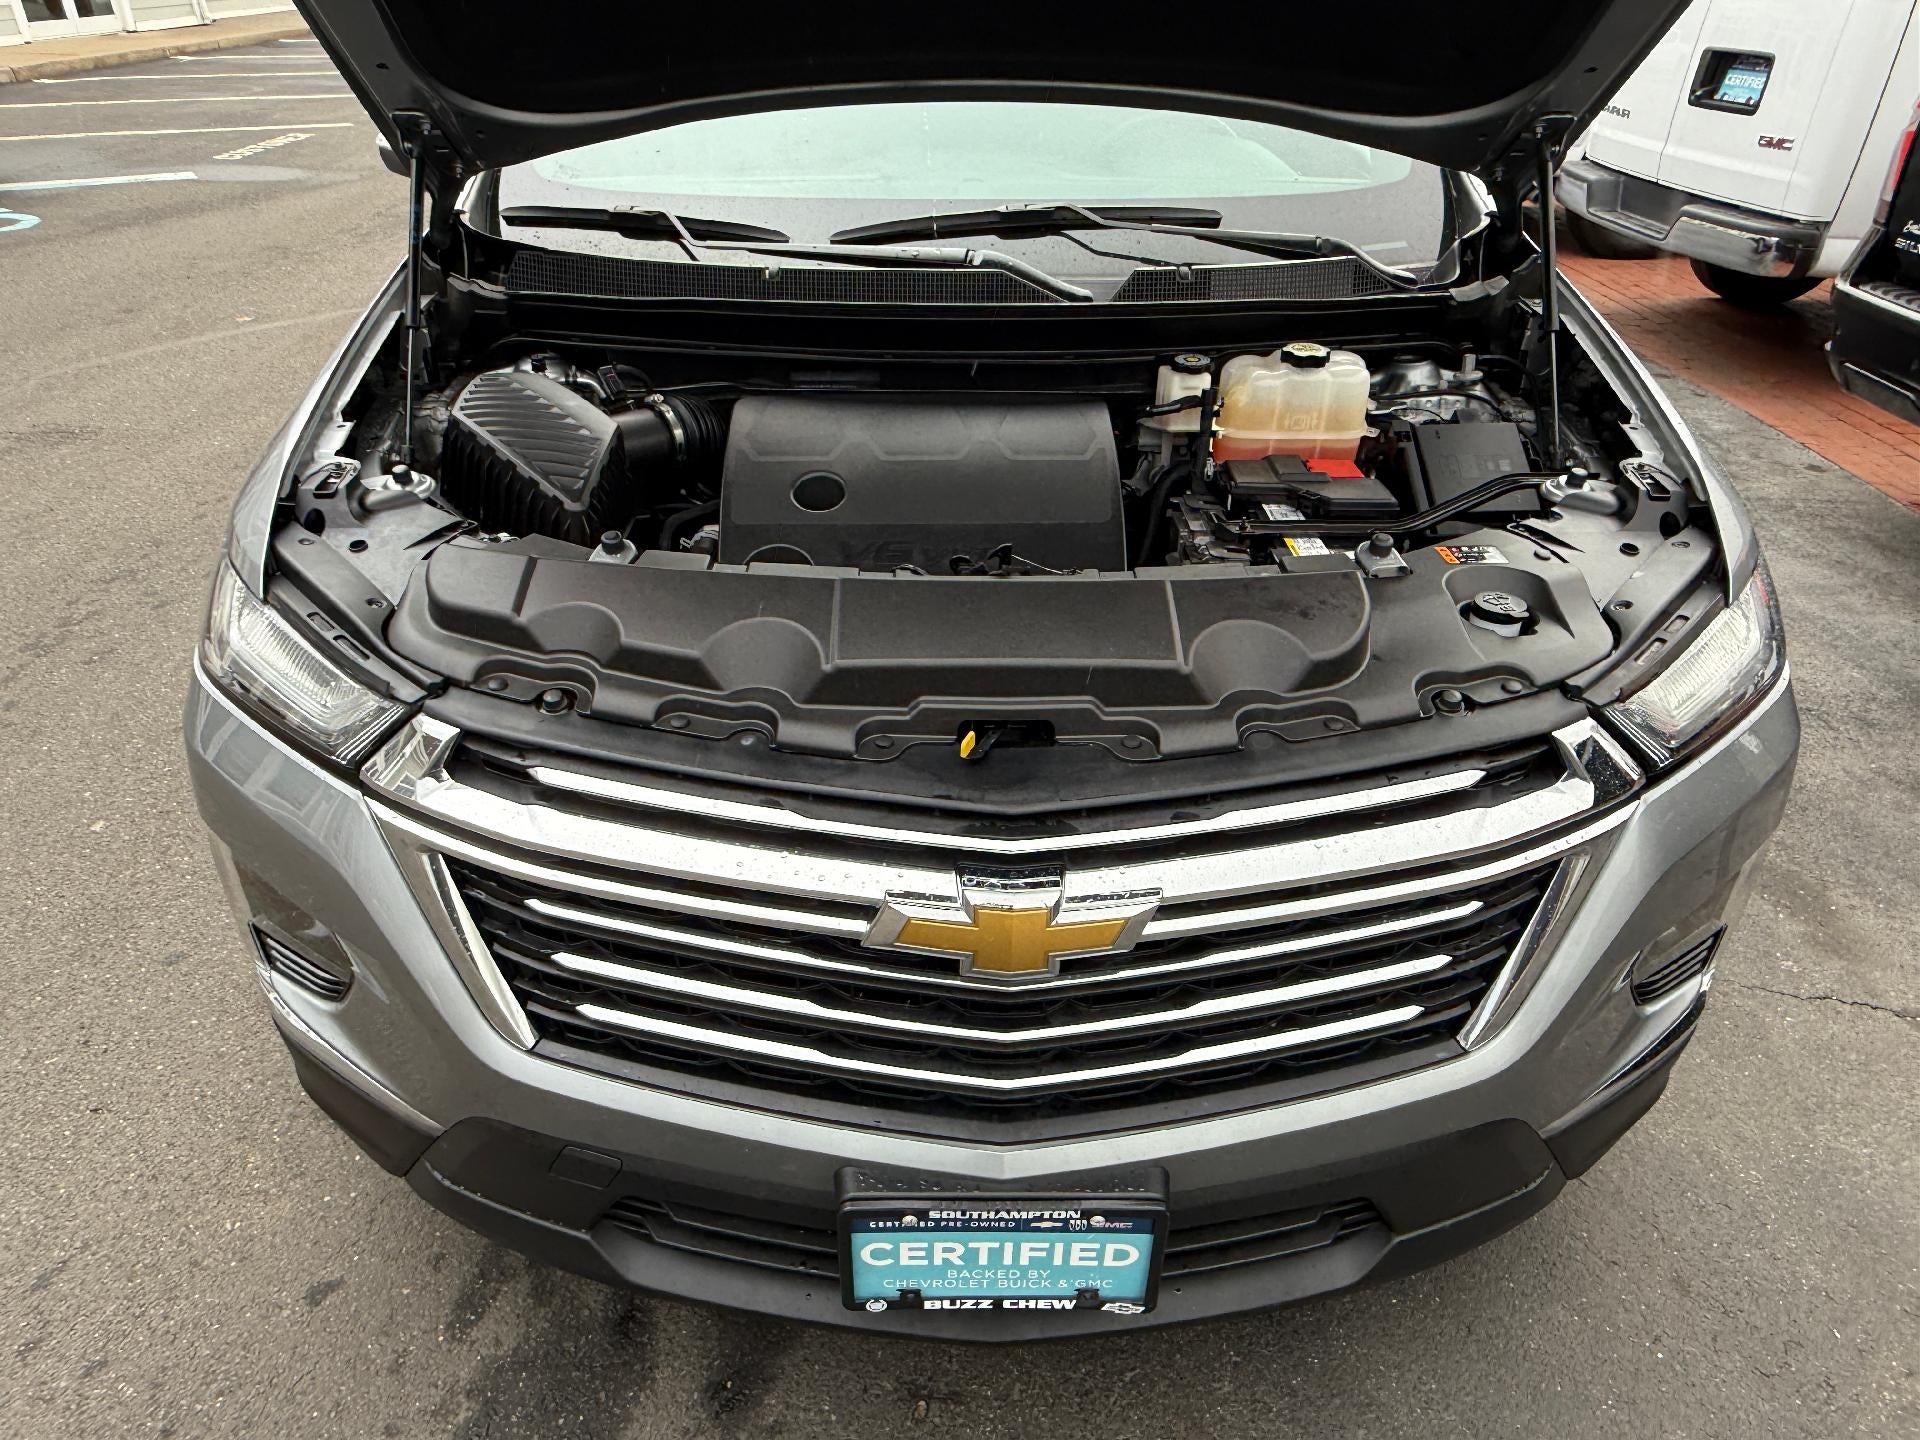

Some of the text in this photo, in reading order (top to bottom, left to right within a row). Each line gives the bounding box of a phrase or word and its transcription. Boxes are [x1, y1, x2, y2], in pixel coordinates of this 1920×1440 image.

[1758, 135, 1795, 151] GMC
[928, 1210, 1081, 1219] SOUTHAMPTON
[860, 1241, 1140, 1266] CERTIFIED
[947, 1269, 1051, 1279] BACKED BY
[883, 1279, 1113, 1288] CHEVROLET BUICK & GMC
[923, 1299, 1077, 1310] BUZZ CHEW
